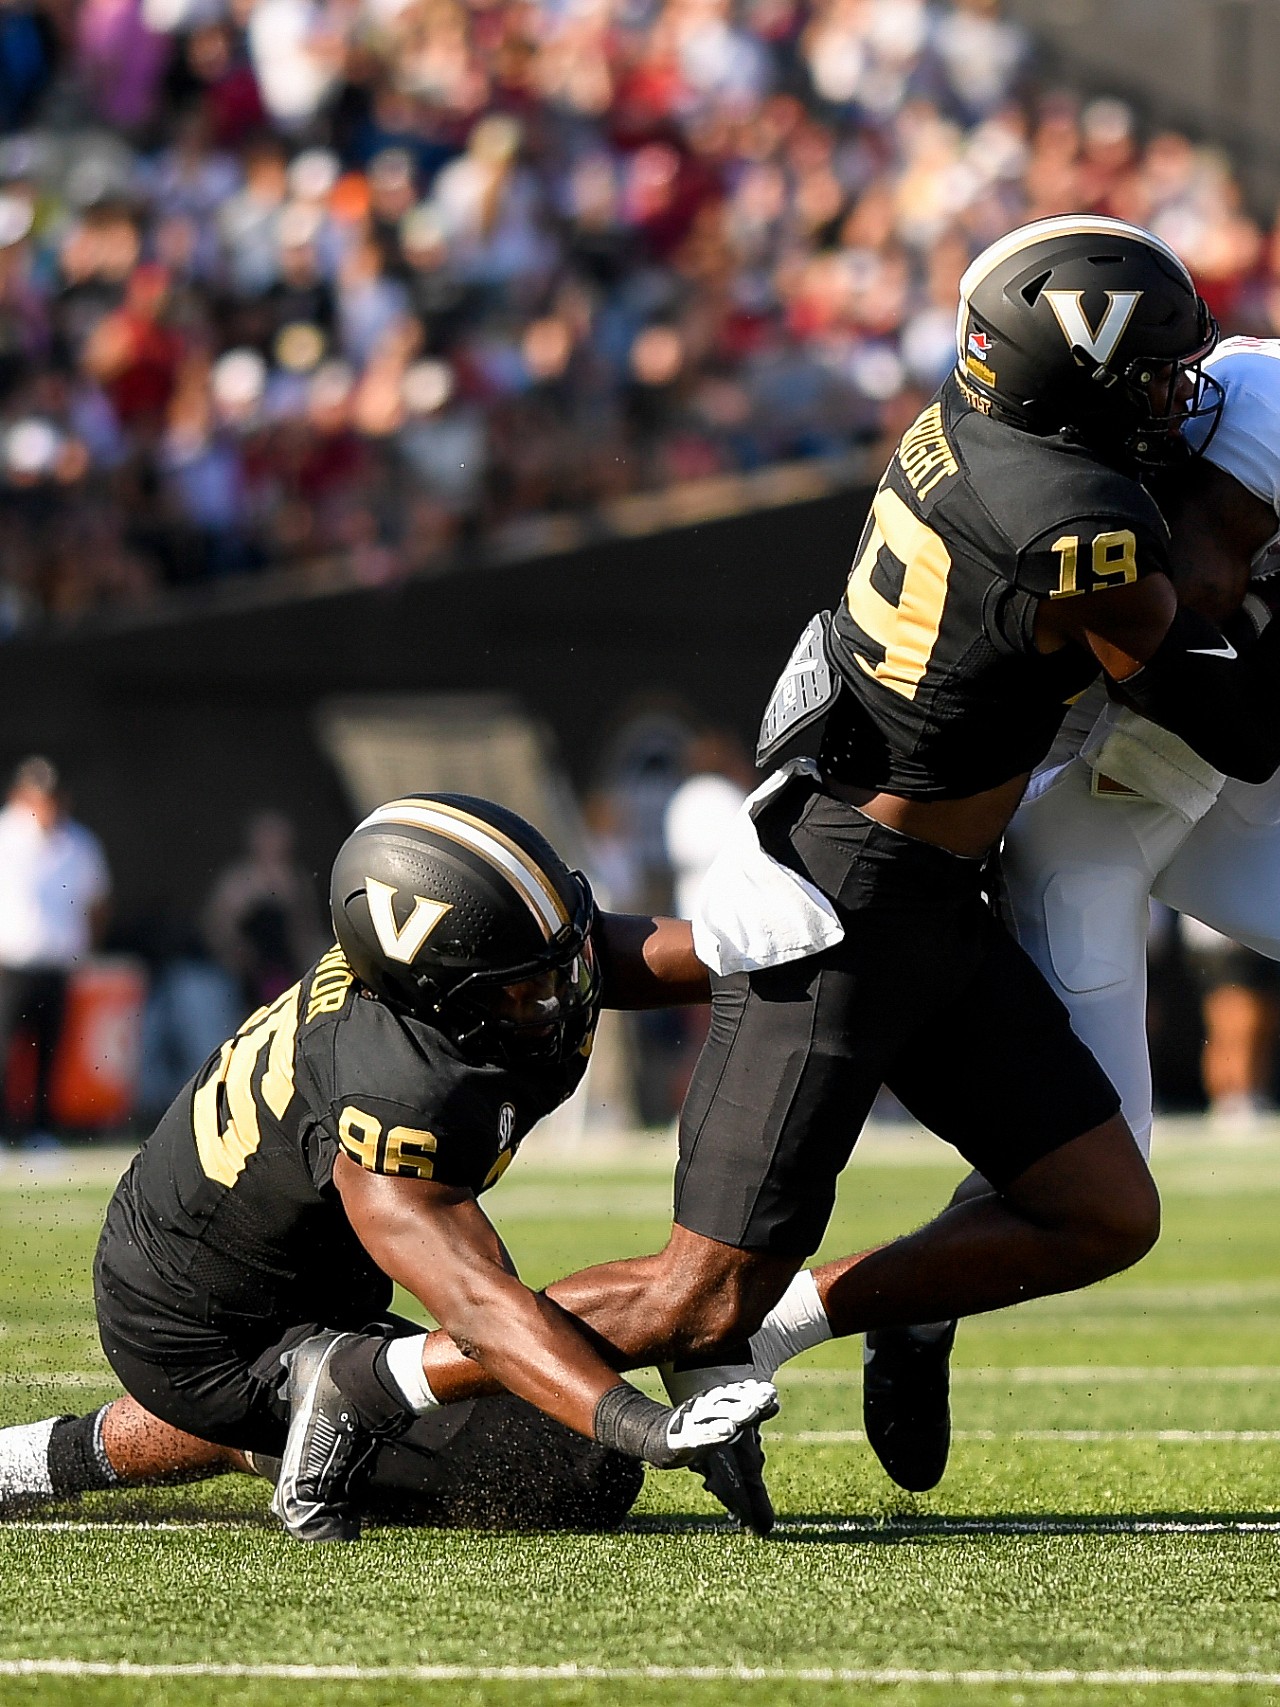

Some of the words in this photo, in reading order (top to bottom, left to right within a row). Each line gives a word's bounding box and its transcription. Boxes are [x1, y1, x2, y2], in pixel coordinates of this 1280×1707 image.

[1042, 290, 1144, 367] V
[1049, 529, 1138, 600] 19
[364, 875, 454, 965] V
[305, 941, 355, 1025] NOR
[338, 1104, 438, 1180] 96
